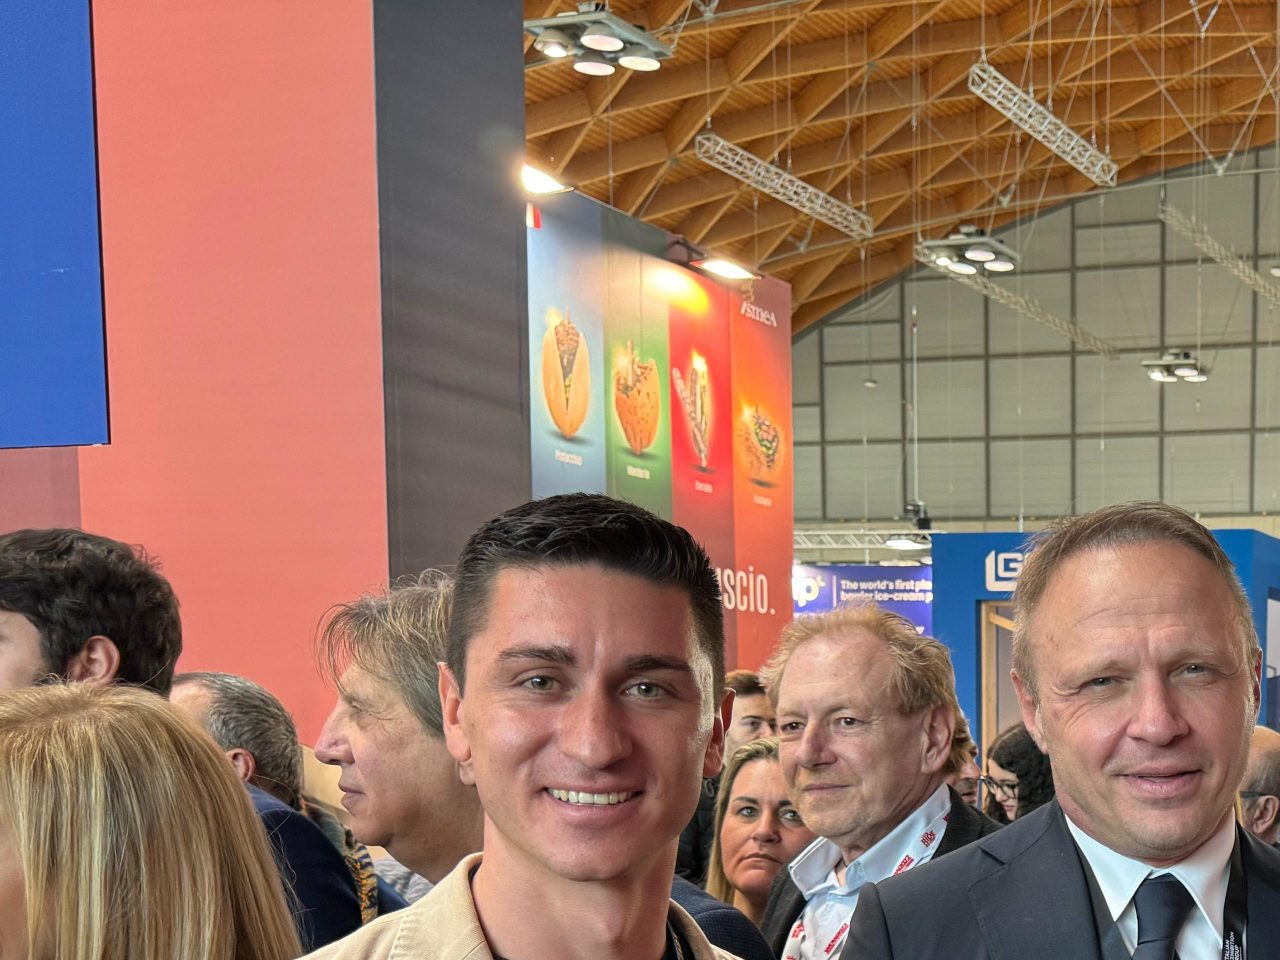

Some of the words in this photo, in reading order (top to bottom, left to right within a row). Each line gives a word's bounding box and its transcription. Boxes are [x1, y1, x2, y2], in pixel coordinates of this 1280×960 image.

[841, 579, 858, 590] The
[860, 579, 894, 590] world's
[895, 579, 914, 590] first
[874, 591, 925, 602] ice-cream
